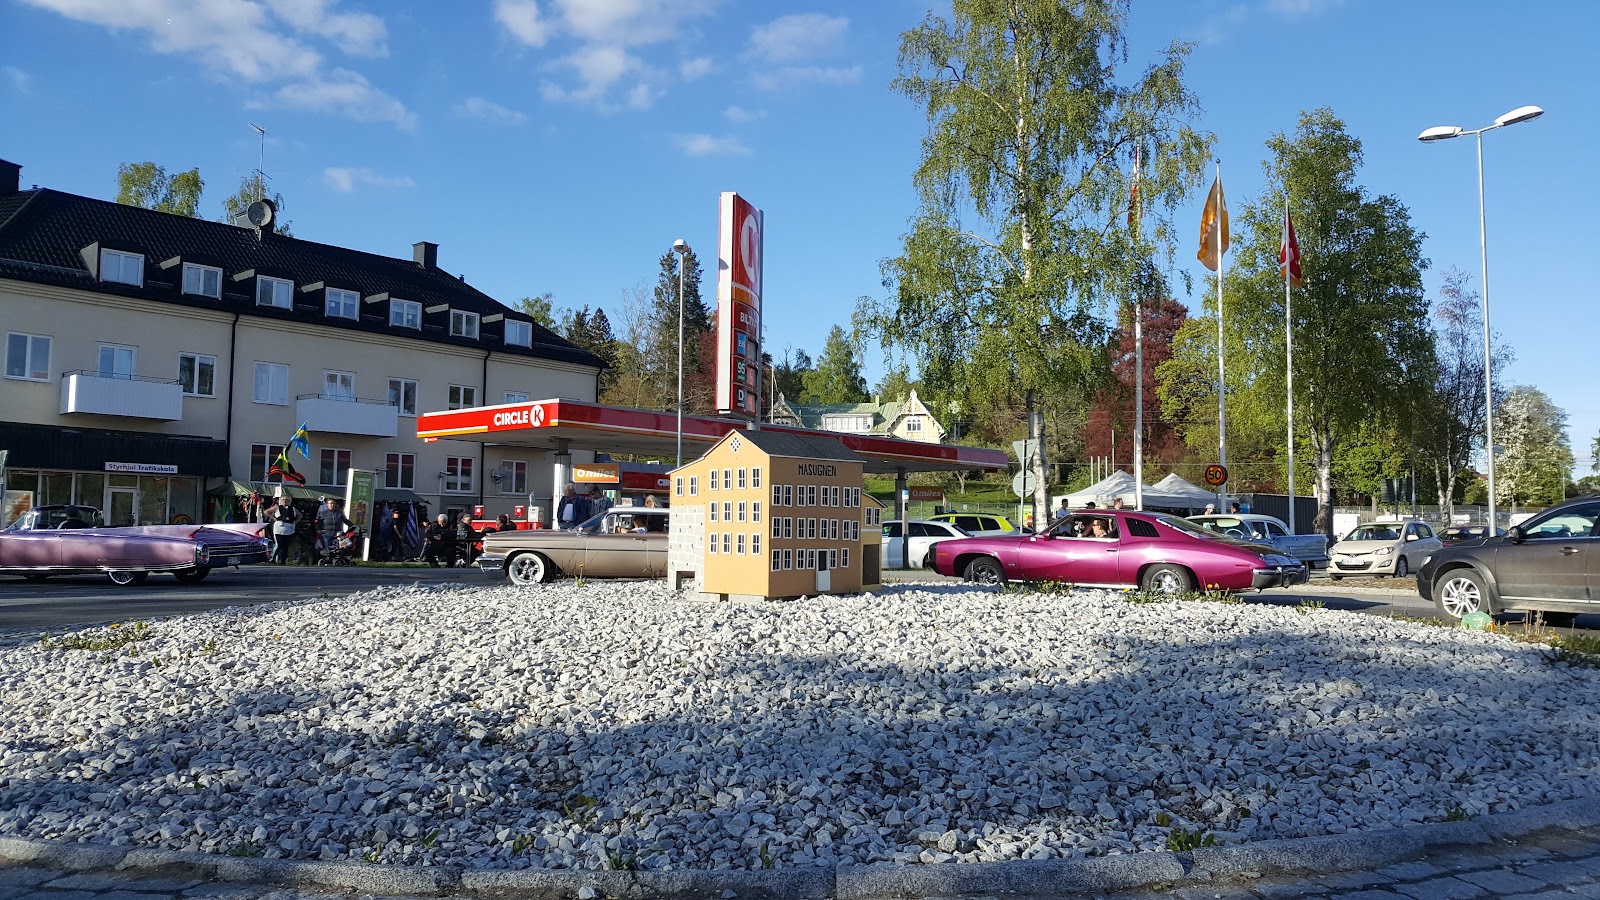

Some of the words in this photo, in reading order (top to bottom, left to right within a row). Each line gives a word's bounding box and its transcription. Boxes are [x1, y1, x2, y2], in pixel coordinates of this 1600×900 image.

[737, 362, 746, 375] 95
[738, 388, 744, 401] D
[494, 410, 529, 426] CIRCLE
[108, 463, 136, 471] Styrhjul
[137, 464, 175, 472] Trafikskola
[798, 463, 837, 477] MASUGNEN
[1208, 470, 1222, 480] 50
